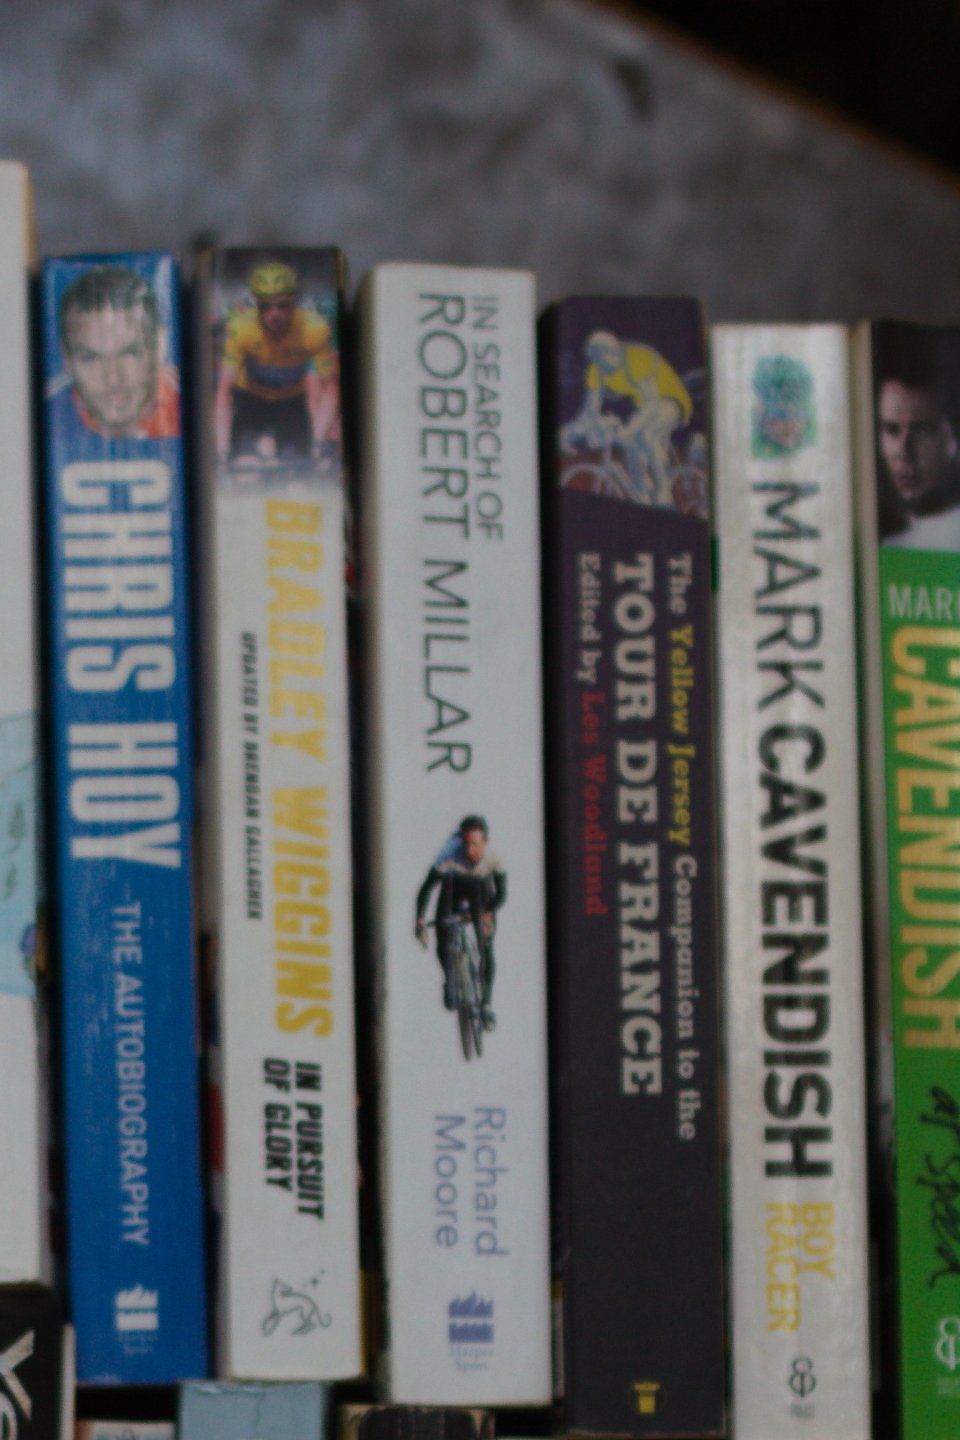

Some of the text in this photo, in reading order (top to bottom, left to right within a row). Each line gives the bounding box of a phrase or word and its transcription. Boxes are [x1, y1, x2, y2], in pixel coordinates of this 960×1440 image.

[473, 298, 504, 543] IN SEARCH OF
[415, 293, 472, 777] ROBERT MILLAR
[578, 551, 603, 644] Edited
[60, 459, 182, 872] CHRIS HOY
[572, 650, 603, 685] by
[240, 630, 263, 923] UPDATED BRENDAN GALLAGHER
[263, 499, 337, 1039] BRADLEY WIGGINS
[582, 753, 607, 916] Woodland
[613, 553, 662, 1097] TOUR DE FRANCE
[666, 553, 702, 1141] The Yellow Jersey Companion to the
[750, 481, 835, 1180] MARK CAVENDISH
[111, 903, 151, 1249] THE AUTOBIOGRAPHY
[262, 1055, 294, 1193] OF GLORY
[294, 1059, 326, 1222] IN PURSUIT
[430, 1114, 467, 1249] Moore
[473, 1105, 509, 1257] Richard
[765, 1202, 800, 1331] RACER
[801, 1202, 836, 1279] BOY
